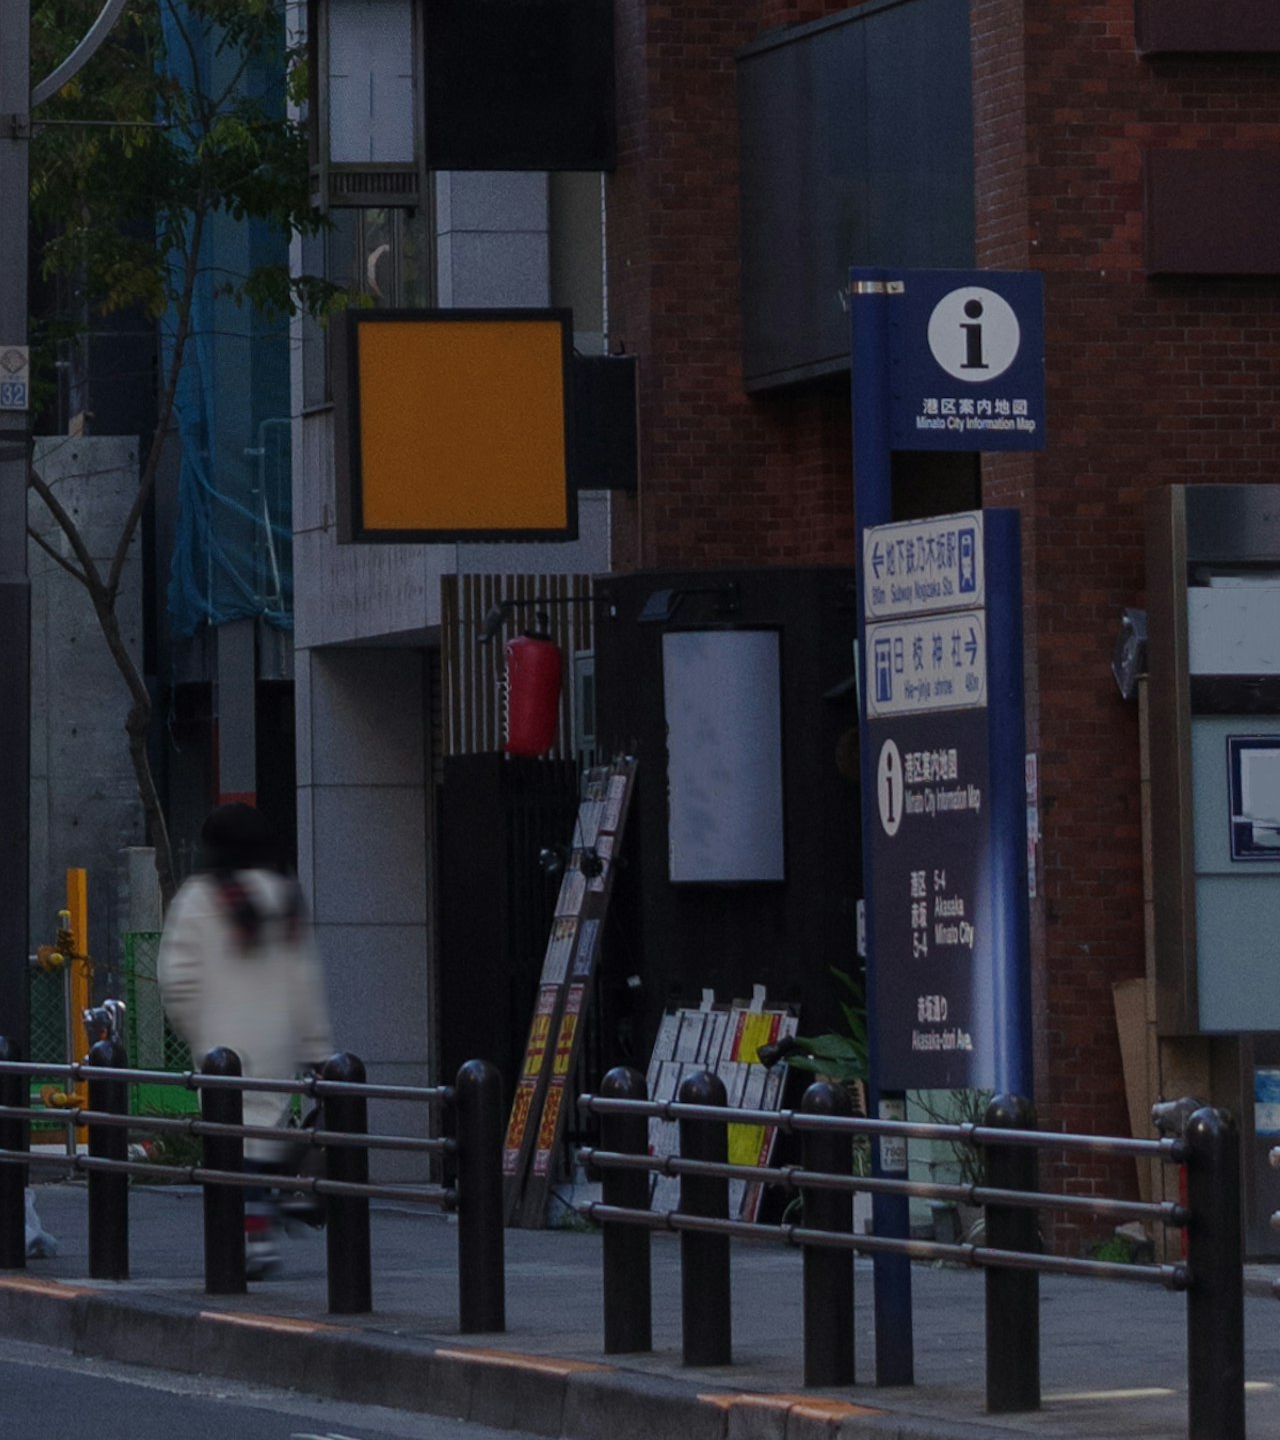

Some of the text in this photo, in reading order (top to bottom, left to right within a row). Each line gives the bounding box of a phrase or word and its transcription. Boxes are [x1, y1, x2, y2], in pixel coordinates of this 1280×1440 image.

[3, 382, 25, 405] 32
[922, 398, 1028, 416] 港区案内地図
[916, 415, 1036, 433] Minato City Information Map
[894, 631, 963, 673] 日枝神社
[904, 748, 958, 784] 港区案内地図
[934, 894, 965, 918] Akasaka
[917, 994, 948, 1023] 赤坂通り
